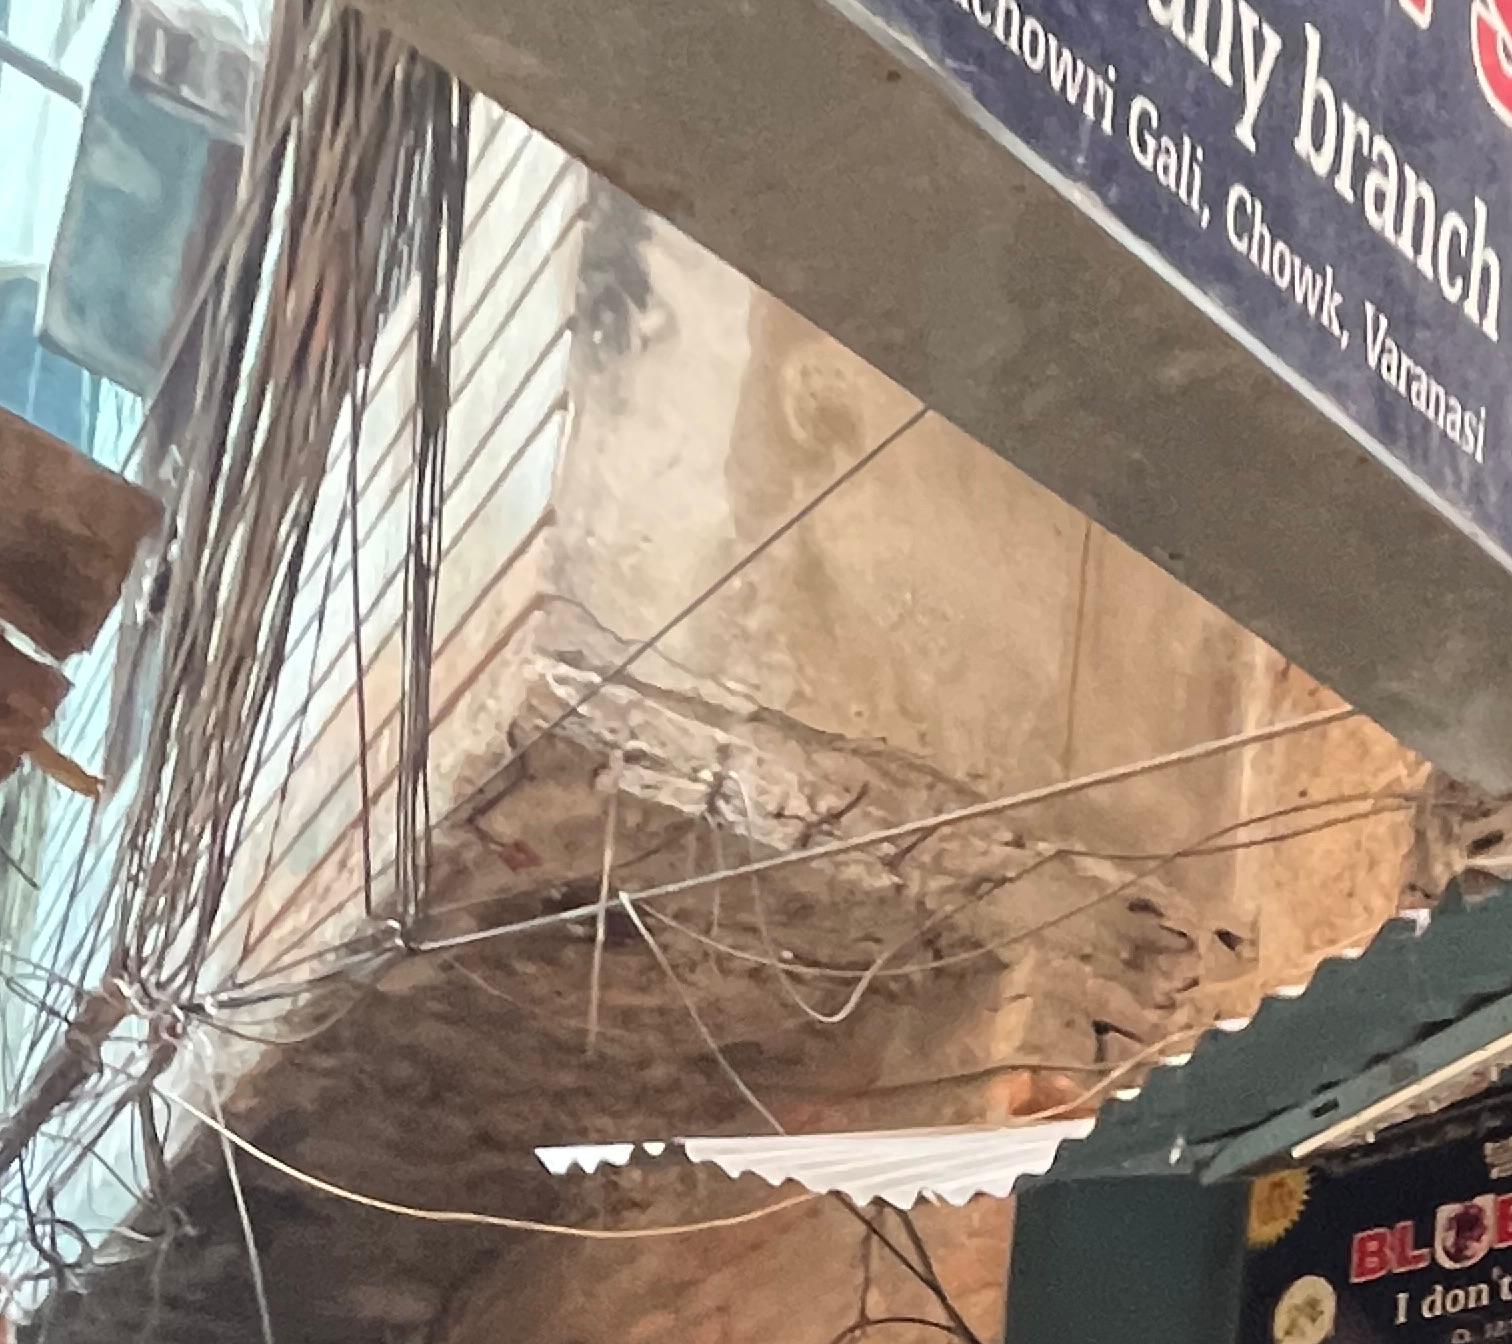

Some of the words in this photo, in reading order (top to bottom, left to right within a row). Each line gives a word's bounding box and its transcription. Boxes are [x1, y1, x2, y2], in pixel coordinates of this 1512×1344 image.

[1128, 94, 1211, 229] Gali,
[1226, 183, 1350, 350] Chowk,
[1364, 300, 1486, 464] Varanasi
[1293, 21, 1501, 342] branch
[1394, 1292, 1410, 1326] I
